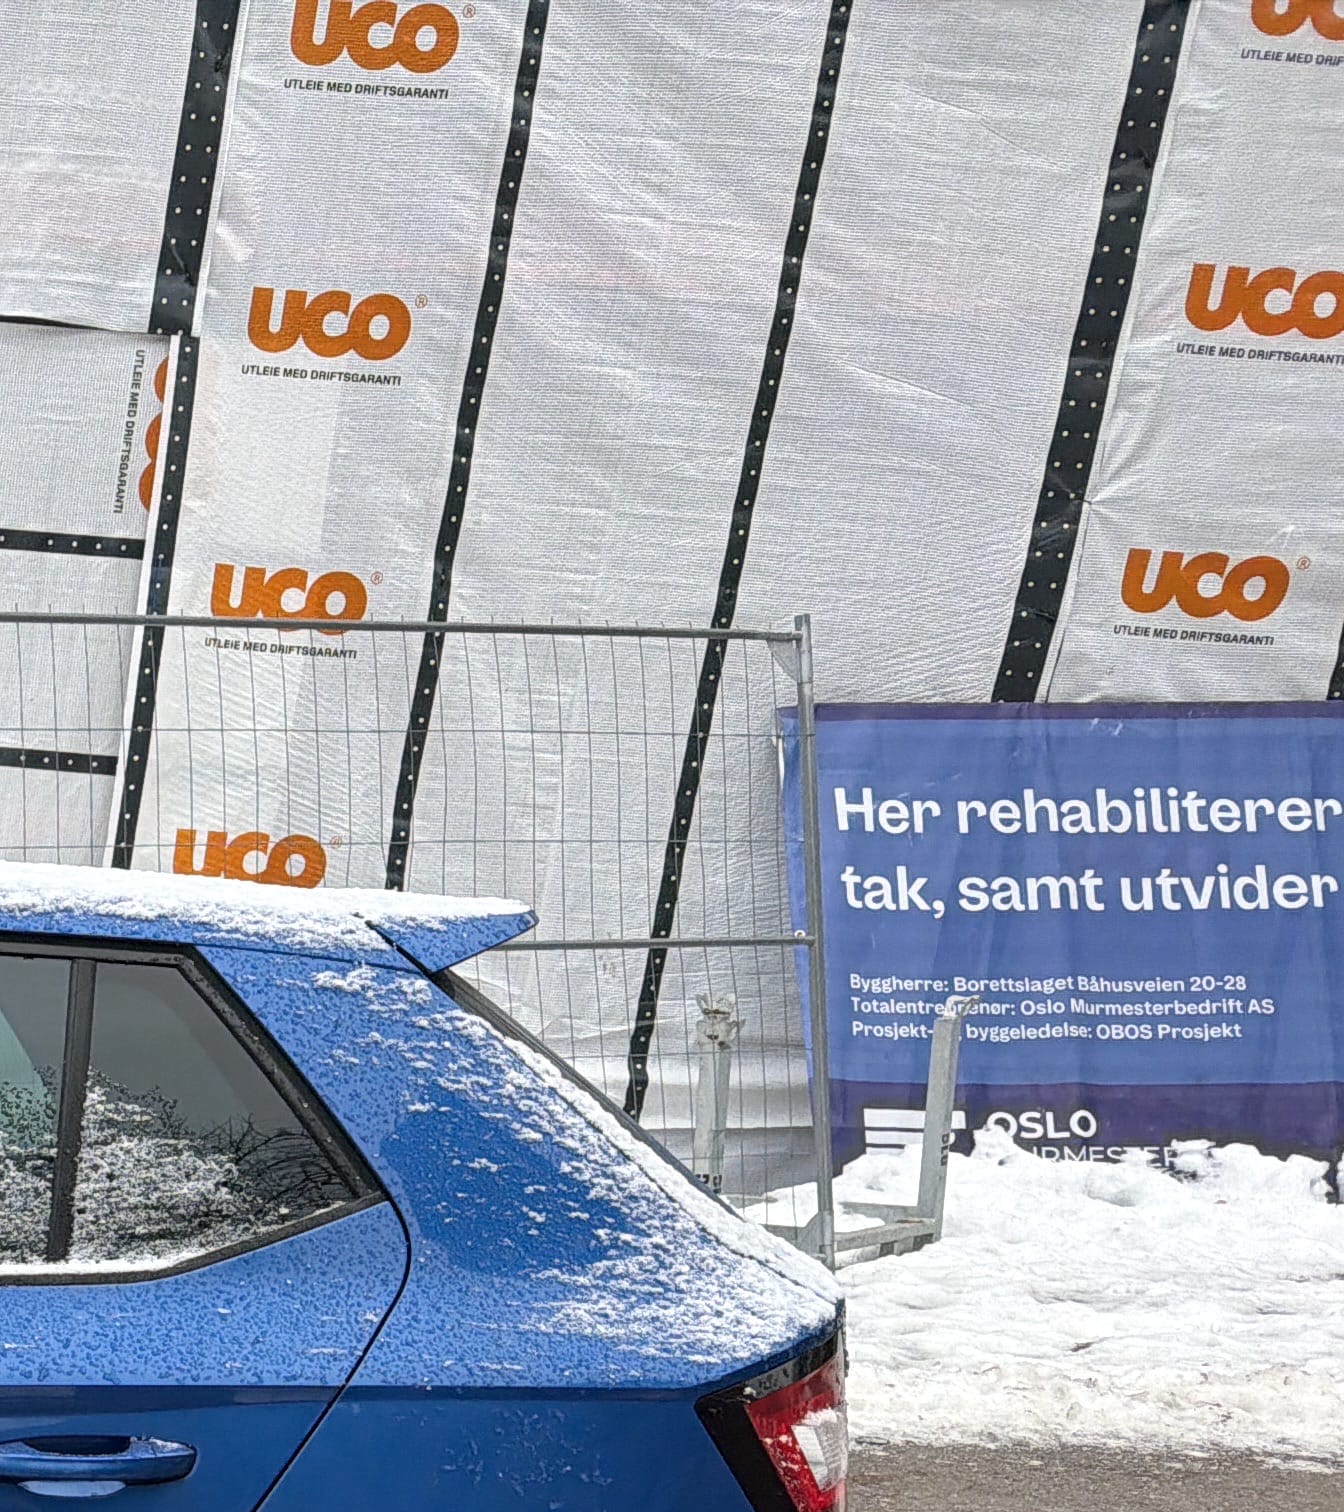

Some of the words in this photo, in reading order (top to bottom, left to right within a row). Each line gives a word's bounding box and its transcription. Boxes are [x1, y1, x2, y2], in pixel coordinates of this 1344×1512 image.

[291, 0, 459, 74] UCO
[1240, 47, 1282, 62] UTLEIE
[1284, 51, 1314, 64] MED
[283, 78, 325, 91] UTLEIE
[326, 81, 353, 94] MED
[354, 83, 450, 100] DRIFTSGARANTI
[247, 286, 413, 361] UCO
[1176, 341, 1217, 357] UTLEIE
[1217, 346, 1246, 359] MED
[130, 349, 145, 390] UTLEIE
[241, 364, 281, 377] UTLEIE
[282, 367, 309, 380] MED
[310, 369, 403, 386] DRIFTSGARANTI
[126, 391, 140, 419] MED
[112, 420, 136, 514] DRIFTSGARANTI
[1121, 548, 1291, 622] UCO
[1113, 624, 1152, 638] UTLEIE
[1152, 627, 1179, 640] MED
[1179, 630, 1275, 646] DRIFTSGARANTI
[204, 637, 242, 652] UTLEIE
[242, 641, 269, 655] MED
[269, 643, 358, 660] DRIFTSGARANTI
[833, 786, 942, 834] Her
[957, 786, 1343, 835] rehabiliterer
[840, 864, 946, 919] tak,
[957, 867, 1104, 912] samt
[1120, 863, 1340, 912] utvider
[849, 973, 950, 994] Byggherre:
[953, 975, 1075, 995] Borettslaget
[1077, 975, 1185, 993] Båhusveien
[1189, 975, 1247, 992] 20-28
[1020, 998, 1066, 1016] Oslo
[1070, 997, 1244, 1016] Murmesterbedrift
[1247, 998, 1275, 1015] AS
[965, 1021, 1093, 1042] byggeledelse:
[1096, 1023, 1153, 1040] OBOS
[1157, 1022, 1243, 1042] Prosjekt
[986, 1109, 1098, 1140] OSLO
